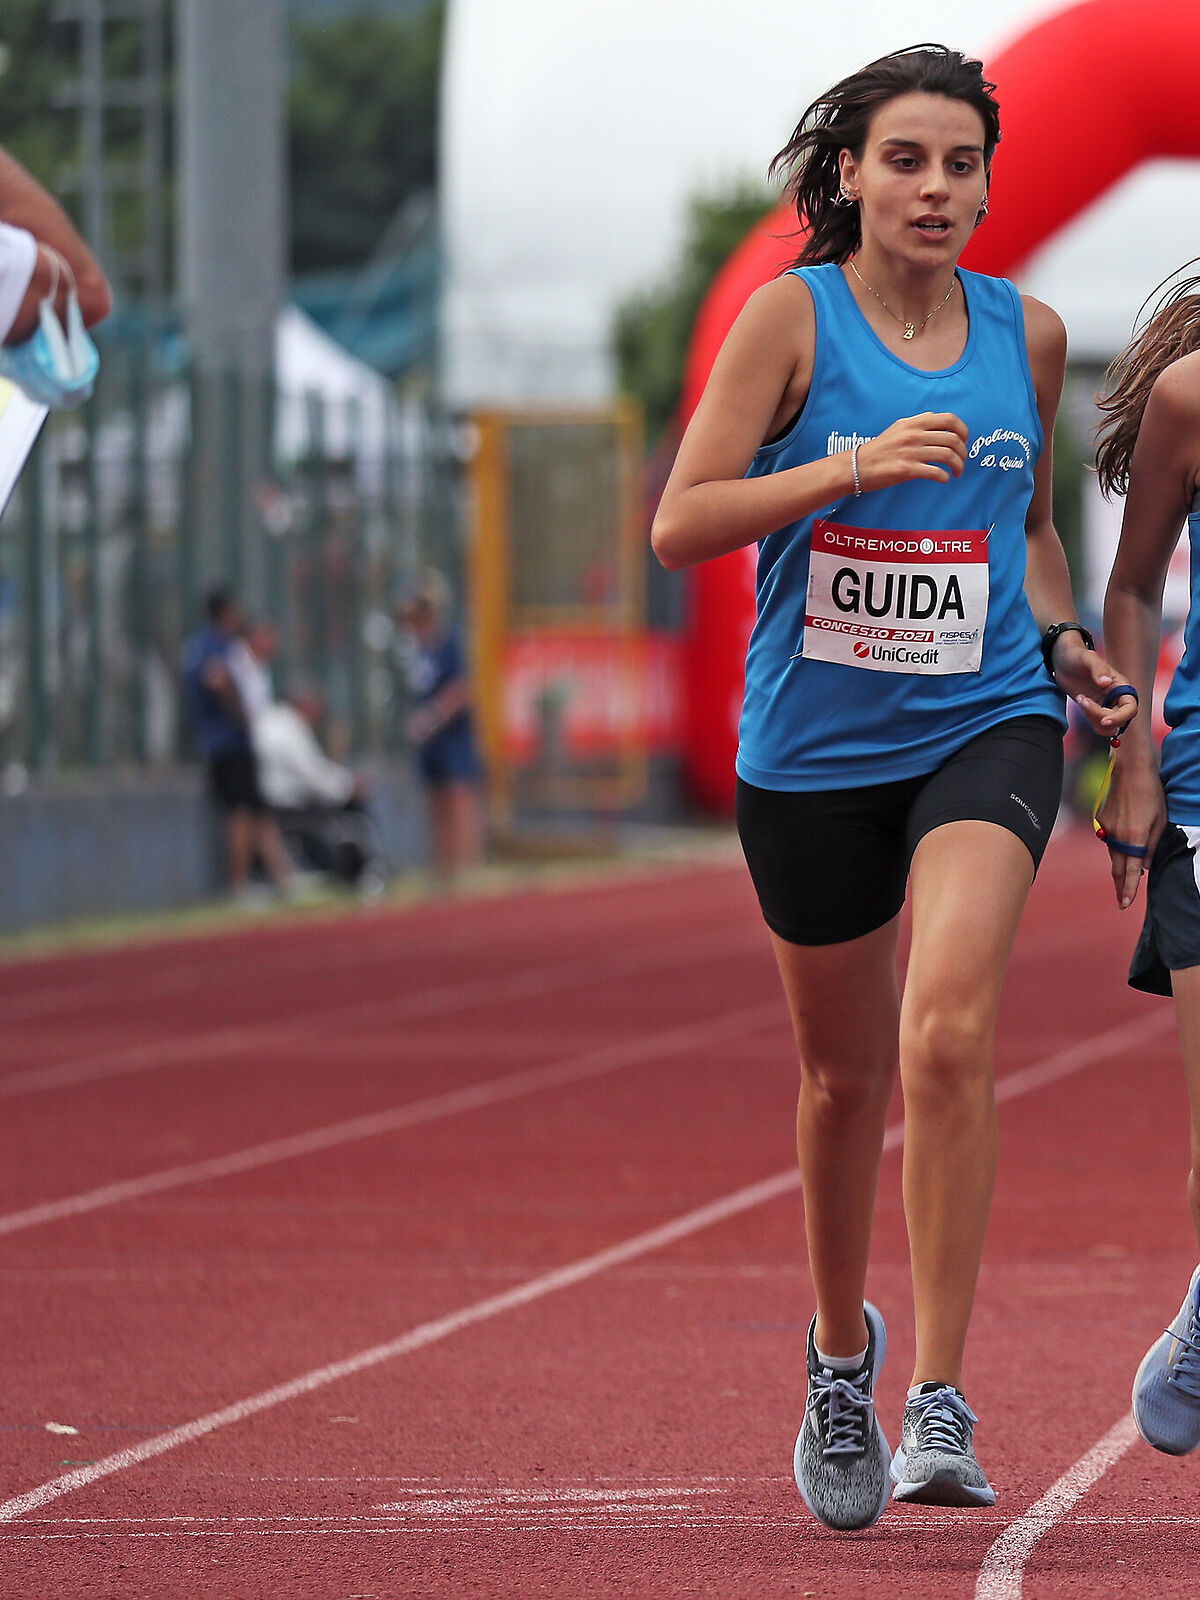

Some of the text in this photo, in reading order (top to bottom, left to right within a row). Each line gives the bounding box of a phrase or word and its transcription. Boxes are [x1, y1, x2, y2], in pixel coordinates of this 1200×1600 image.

[831, 567, 965, 620] GUIDA
[812, 618, 931, 641] CONCESIO 2021
[872, 647, 939, 664] UniCredit
